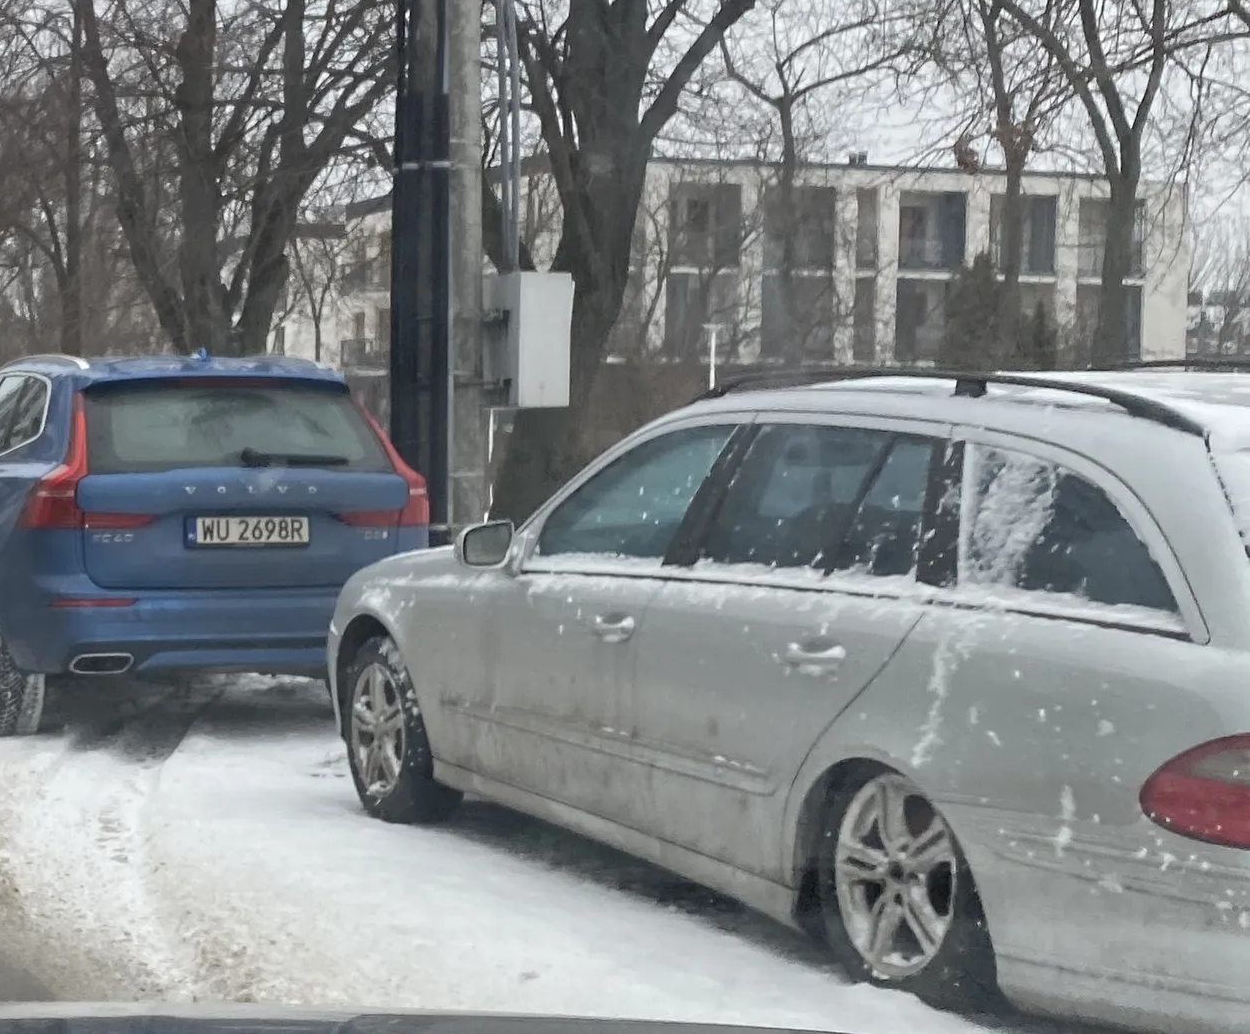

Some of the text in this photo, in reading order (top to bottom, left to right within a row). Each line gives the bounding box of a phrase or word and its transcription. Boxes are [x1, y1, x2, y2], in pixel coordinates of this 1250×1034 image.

[184, 485, 318, 495] VOLVO
[201, 518, 304, 542] WU 2698R
